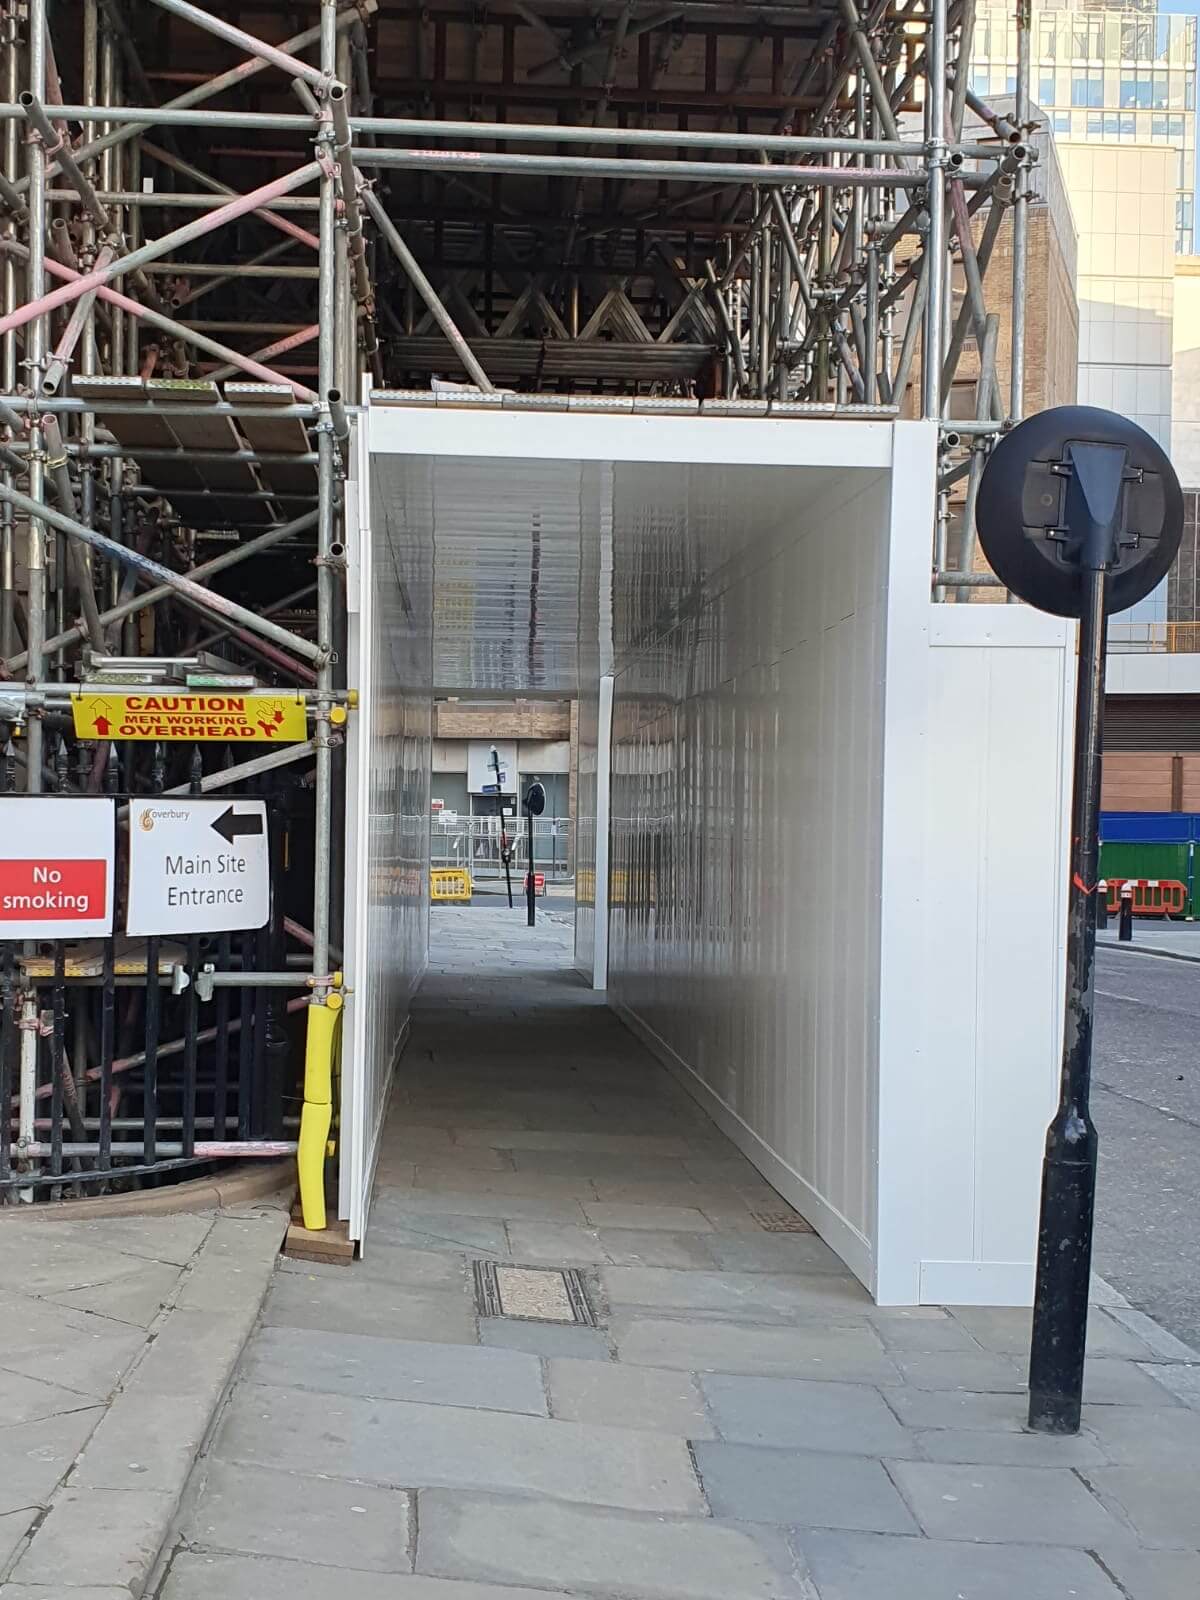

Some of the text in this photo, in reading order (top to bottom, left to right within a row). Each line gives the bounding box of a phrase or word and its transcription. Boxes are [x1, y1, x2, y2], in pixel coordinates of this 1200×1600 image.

[126, 697, 245, 711] CAUTION
[124, 715, 248, 725] MEN WORKING
[119, 725, 256, 737] OVERHEAD
[152, 809, 190, 821] overbury
[165, 854, 246, 875] Main Site
[32, 866, 62, 884] No
[3, 891, 89, 912] smoking
[167, 887, 243, 906] Entrance
